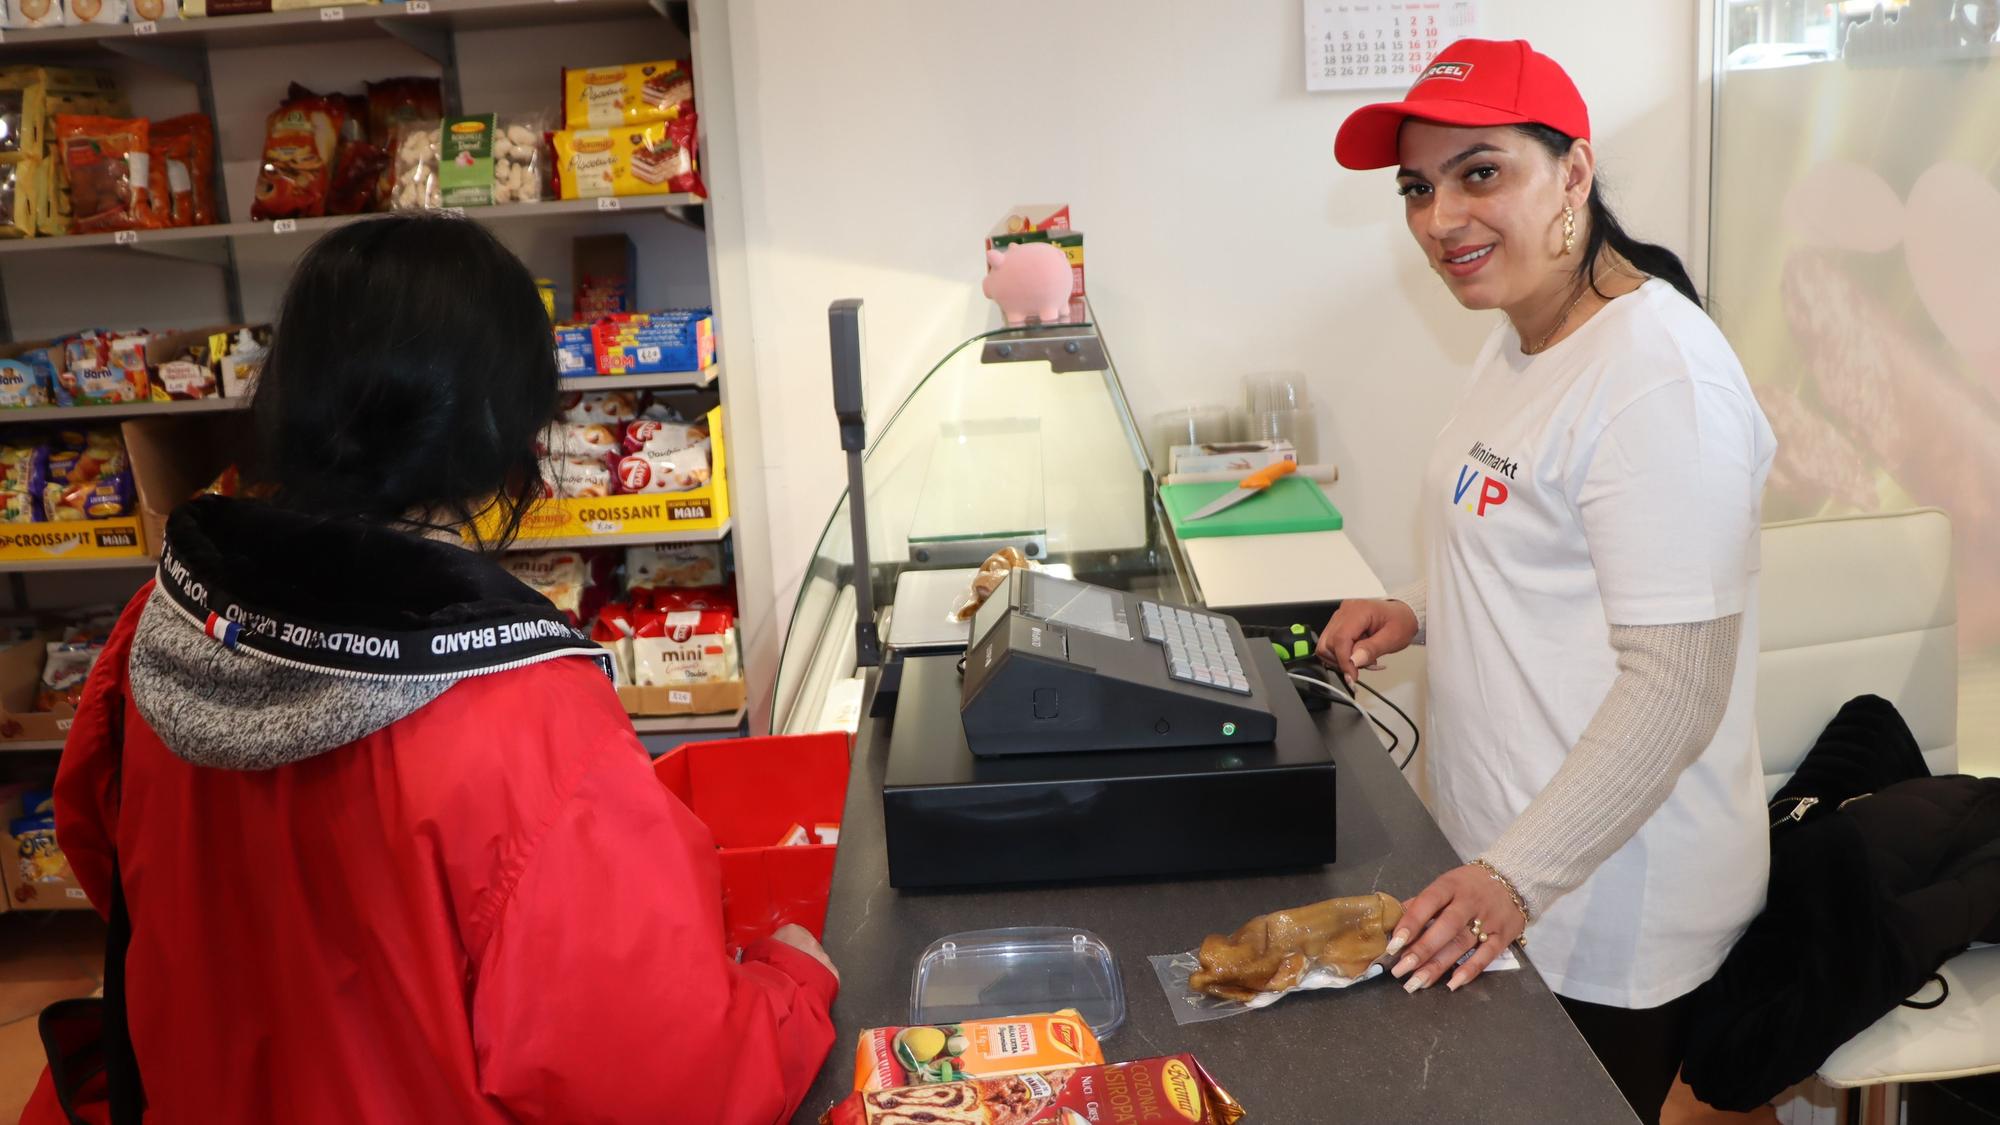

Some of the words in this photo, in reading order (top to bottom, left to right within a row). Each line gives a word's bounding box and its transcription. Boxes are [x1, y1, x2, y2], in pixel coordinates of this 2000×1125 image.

[1394, 17, 1401, 27] 1
[1410, 16, 1418, 27] 2
[1428, 16, 1435, 26] 3
[1325, 30, 1333, 41] 4
[1342, 30, 1350, 41] 5
[1358, 30, 1366, 41] 6
[1376, 30, 1383, 40] 7
[1394, 29, 1401, 39] 8
[1411, 28, 1419, 39] 9
[1425, 28, 1439, 38] 10
[1324, 43, 1335, 53] 11
[1340, 42, 1353, 53] 12
[1356, 42, 1369, 53] 13
[1374, 42, 1387, 51] 14
[1392, 41, 1404, 51] 15
[1409, 40, 1421, 51] 16
[1426, 40, 1438, 50] 17
[1324, 55, 1337, 66] 18
[1341, 54, 1353, 65] 19
[1356, 54, 1370, 65] 20
[1374, 54, 1387, 63] 21
[1392, 53, 1405, 63] 22
[1409, 52, 1421, 63] 23
[1324, 66, 1337, 78] 25
[1341, 66, 1354, 77] 26
[1356, 66, 1371, 77] 27
[1374, 65, 1388, 75] 28
[1392, 64, 1405, 75] 29
[1409, 64, 1422, 75] 30
[600, 355, 635, 369] ROM
[1468, 441, 1518, 480] Minimarkt
[622, 460, 641, 488] 7
[579, 505, 661, 522] CROISSANT
[674, 506, 705, 519] MAIA
[102, 534, 131, 546] MAIA
[512, 556, 555, 573] mini
[280, 623, 400, 659] WORLDWIDE
[431, 627, 497, 655] BRAND
[662, 645, 702, 662] mini
[1018, 1024, 1030, 1052] POLENTA
[1131, 1064, 1161, 1120] COZONAC
[1169, 1062, 1193, 1114] Boromir
